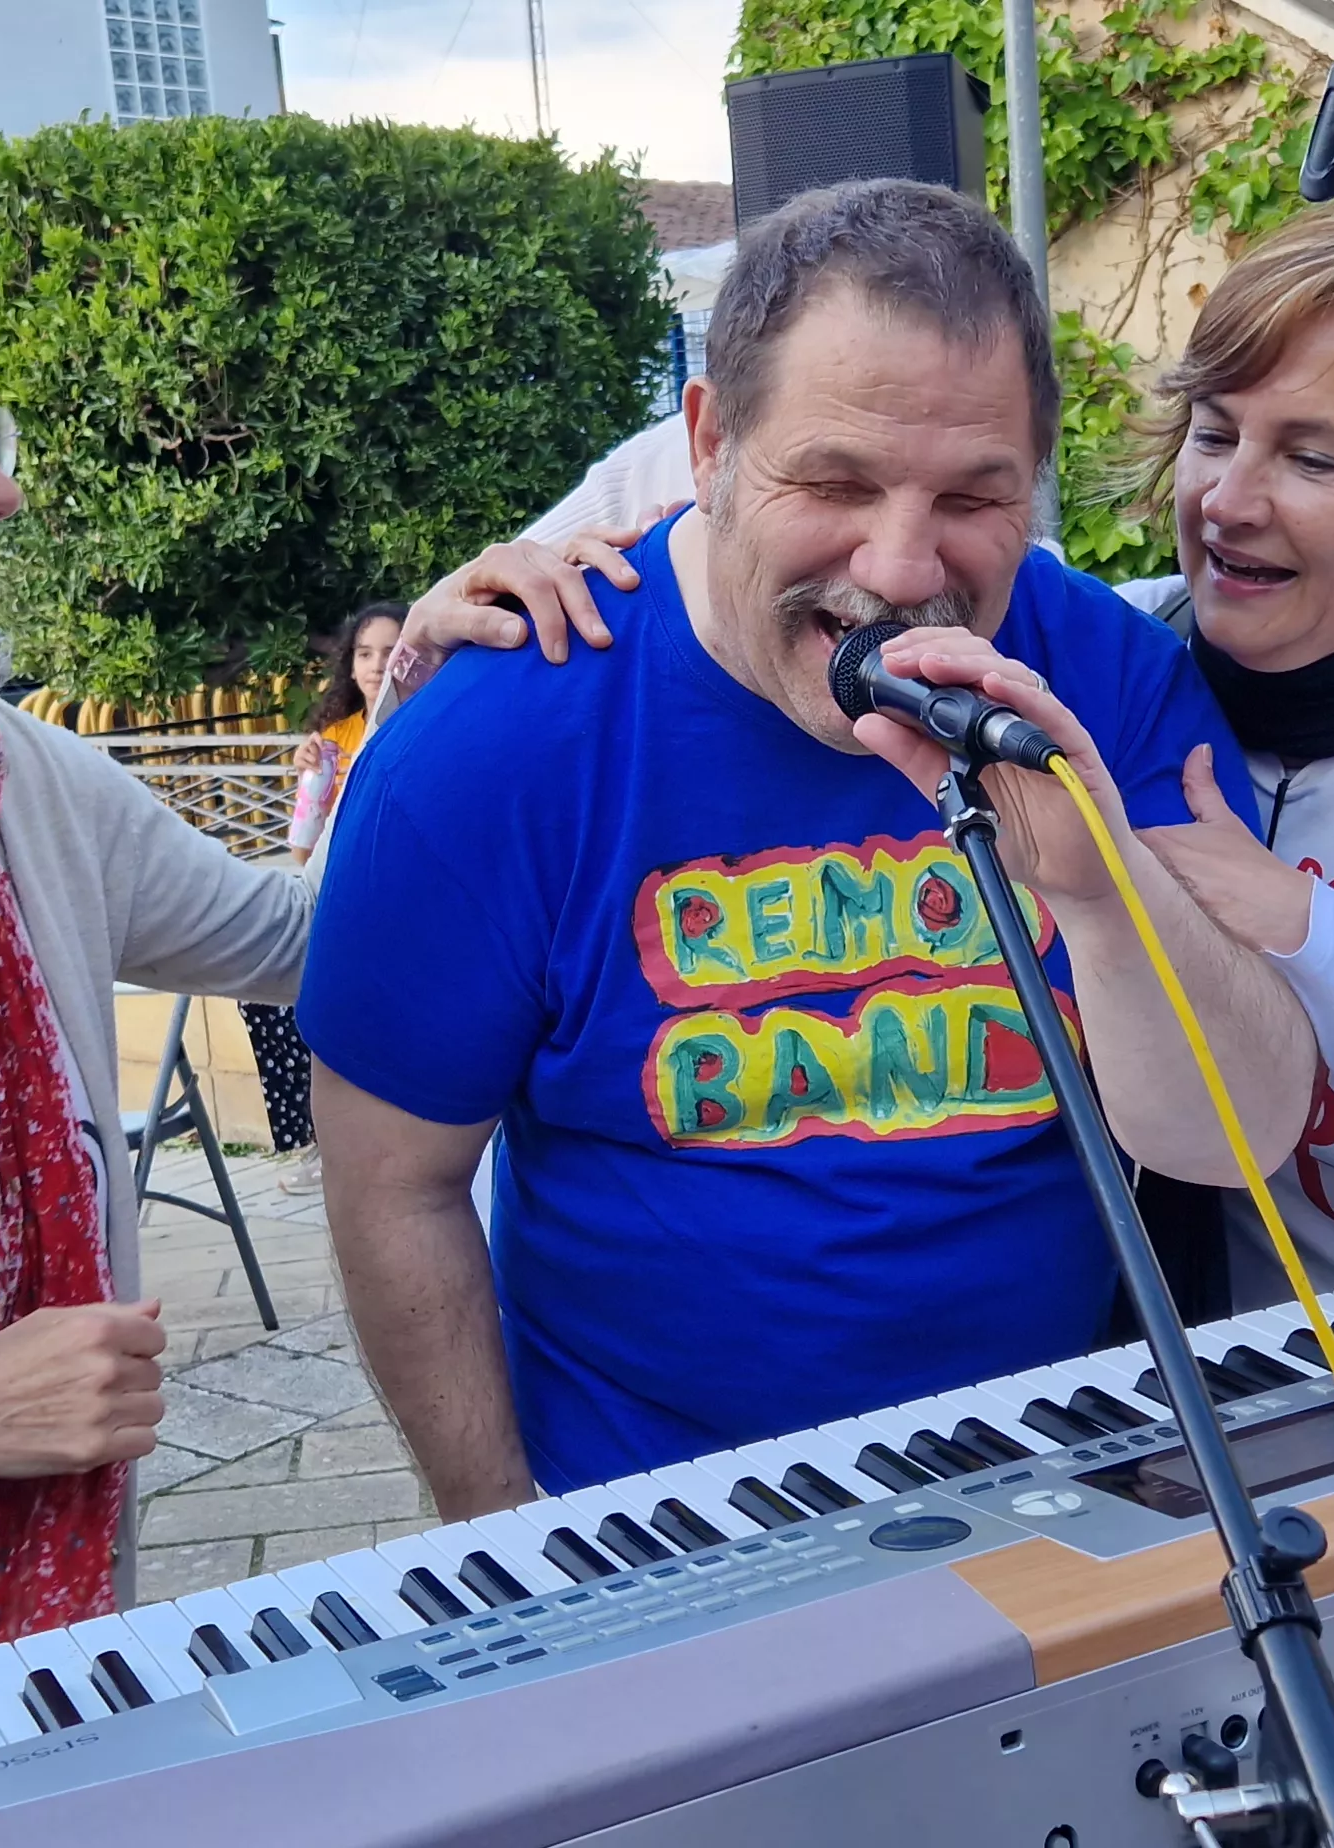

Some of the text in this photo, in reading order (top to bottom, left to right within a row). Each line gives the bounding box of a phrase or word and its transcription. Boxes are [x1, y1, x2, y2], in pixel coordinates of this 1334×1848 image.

[669, 1003, 1054, 1136] BAND
[1231, 1690, 1246, 1702] AUX
[1130, 1721, 1160, 1737] POWER
